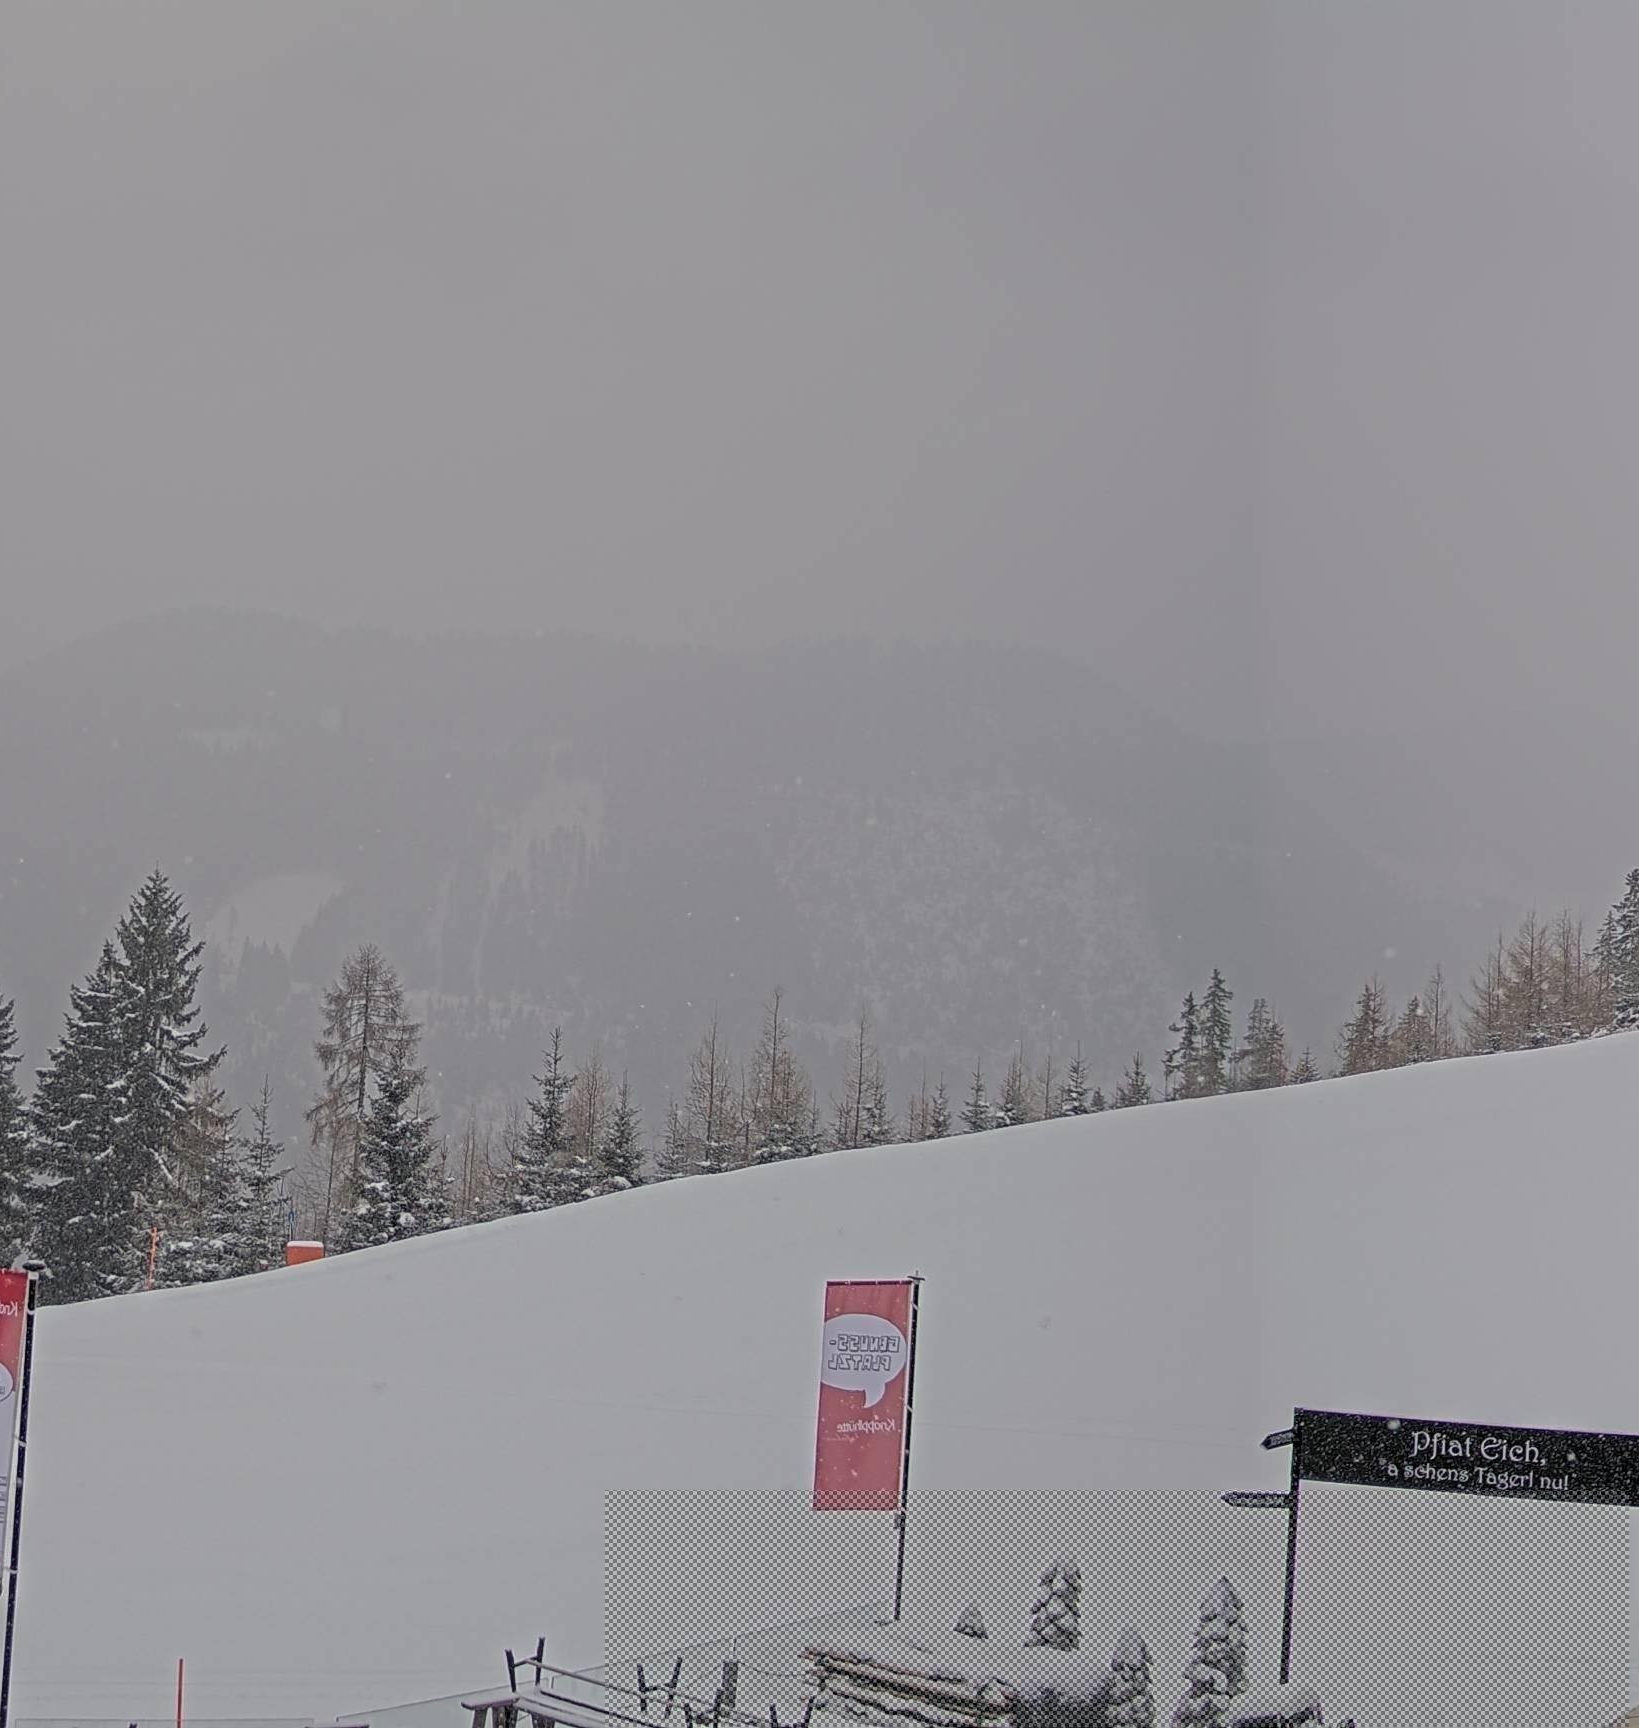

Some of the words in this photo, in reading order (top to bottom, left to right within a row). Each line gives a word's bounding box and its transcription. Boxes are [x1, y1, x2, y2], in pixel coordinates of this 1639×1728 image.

[1409, 1430, 1472, 1460] Pfiat
[1480, 1436, 1546, 1466] Eich,
[1403, 1463, 1469, 1482] schens
